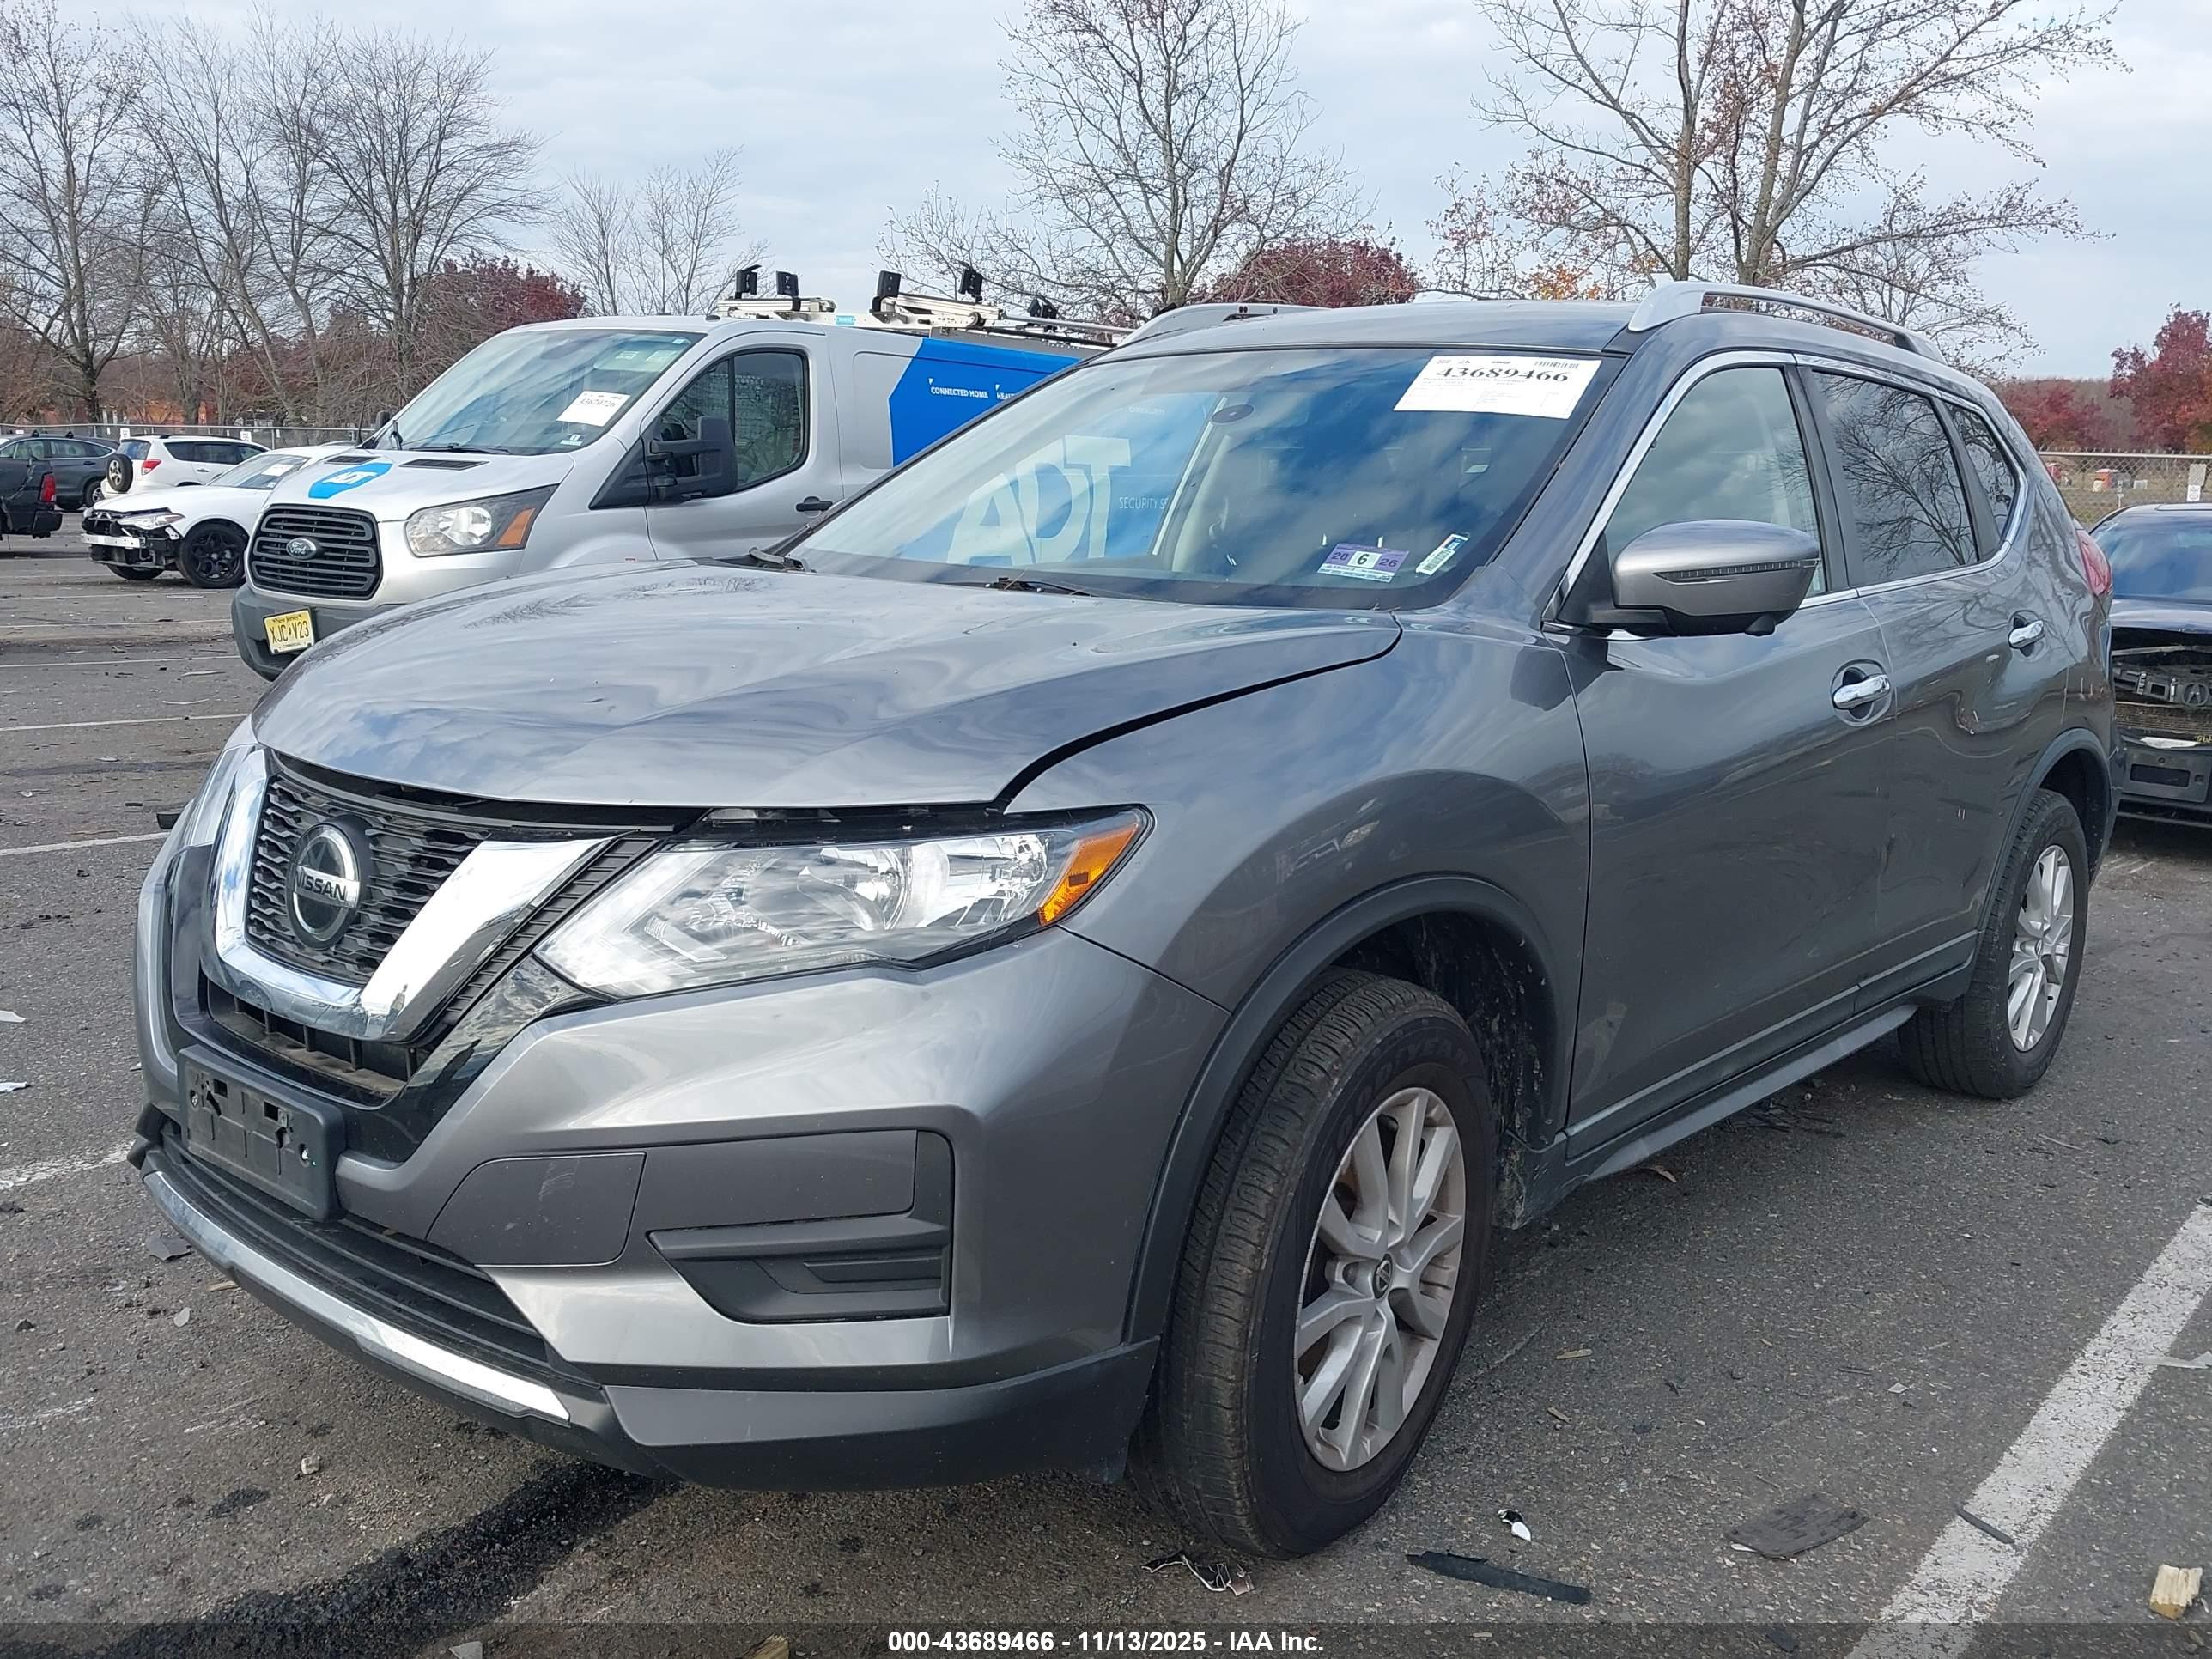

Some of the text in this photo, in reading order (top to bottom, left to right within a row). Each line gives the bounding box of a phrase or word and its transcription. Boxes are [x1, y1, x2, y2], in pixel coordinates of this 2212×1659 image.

[1436, 367, 1569, 383] 43689466
[930, 386, 989, 399] CONNECTED HOME
[946, 434, 1132, 567] ADT
[1119, 496, 1158, 509] SECURITY
[1331, 551, 1399, 568] 20 6 26
[295, 866, 347, 902] NISSAN
